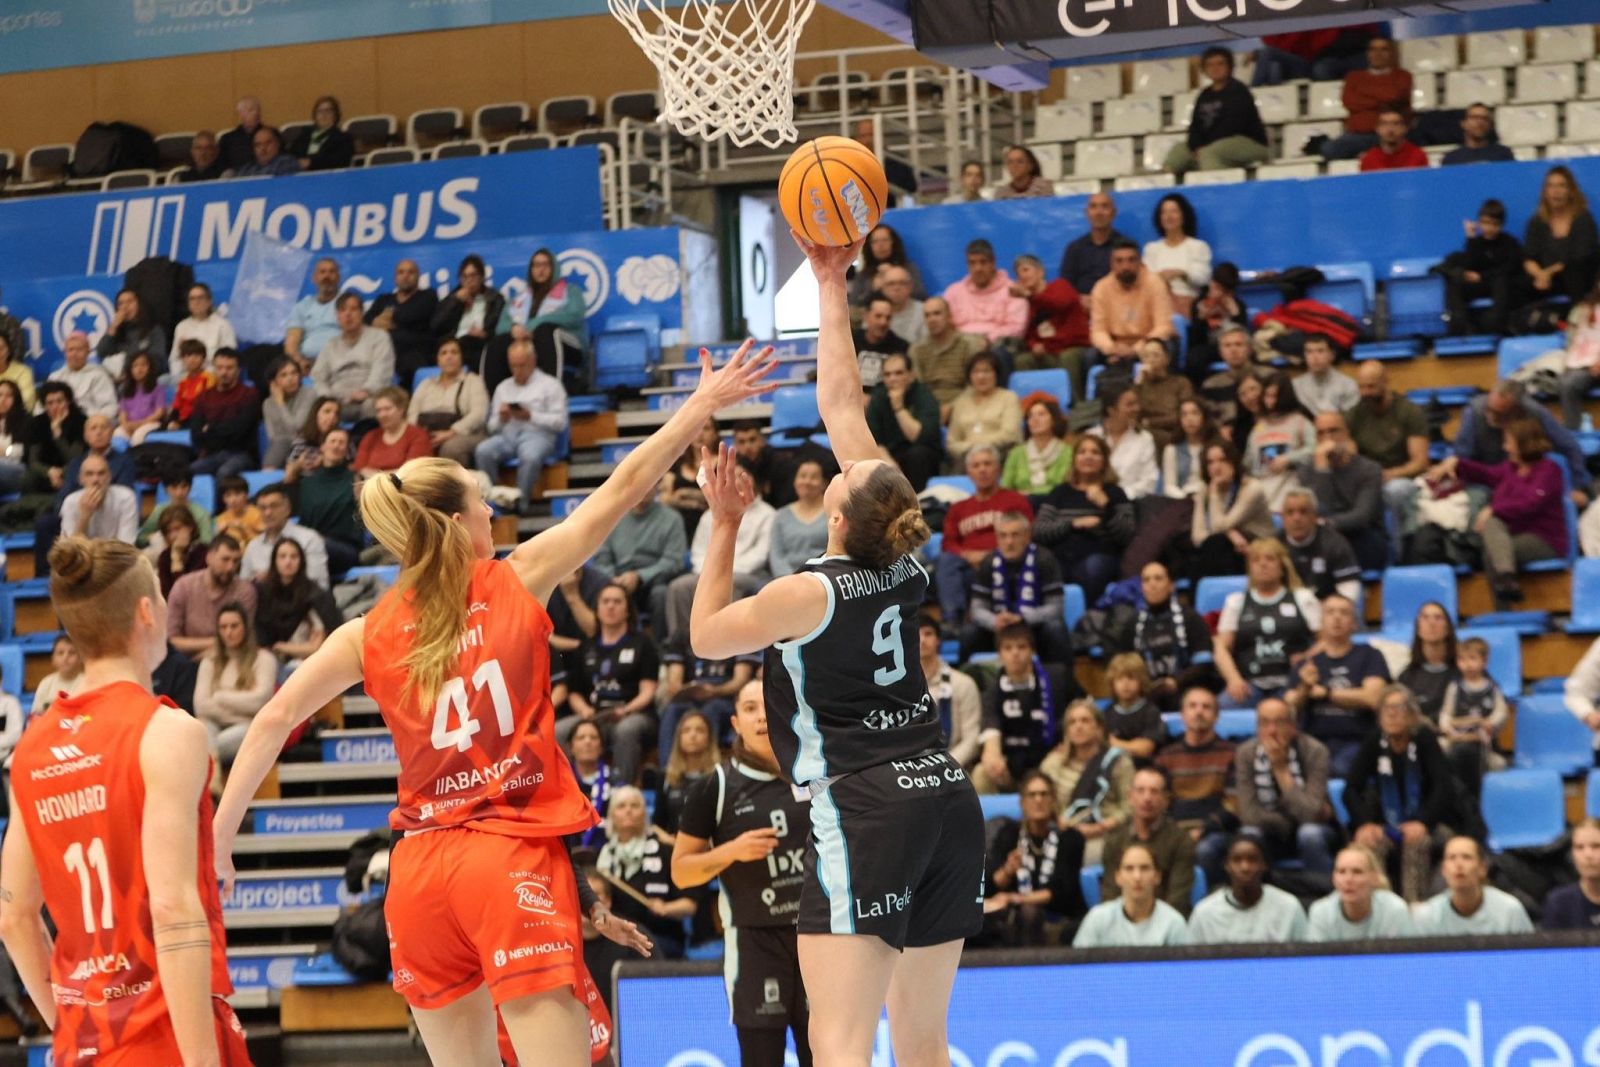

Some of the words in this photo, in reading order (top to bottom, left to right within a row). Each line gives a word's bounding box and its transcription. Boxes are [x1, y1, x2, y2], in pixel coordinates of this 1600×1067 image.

[872, 604, 906, 686] 9
[430, 658, 515, 752] 41
[35, 784, 106, 825] HOWARD
[769, 808, 788, 838] 8
[63, 836, 114, 934] 11
[856, 898, 883, 918] La
[508, 944, 533, 960] NEW
